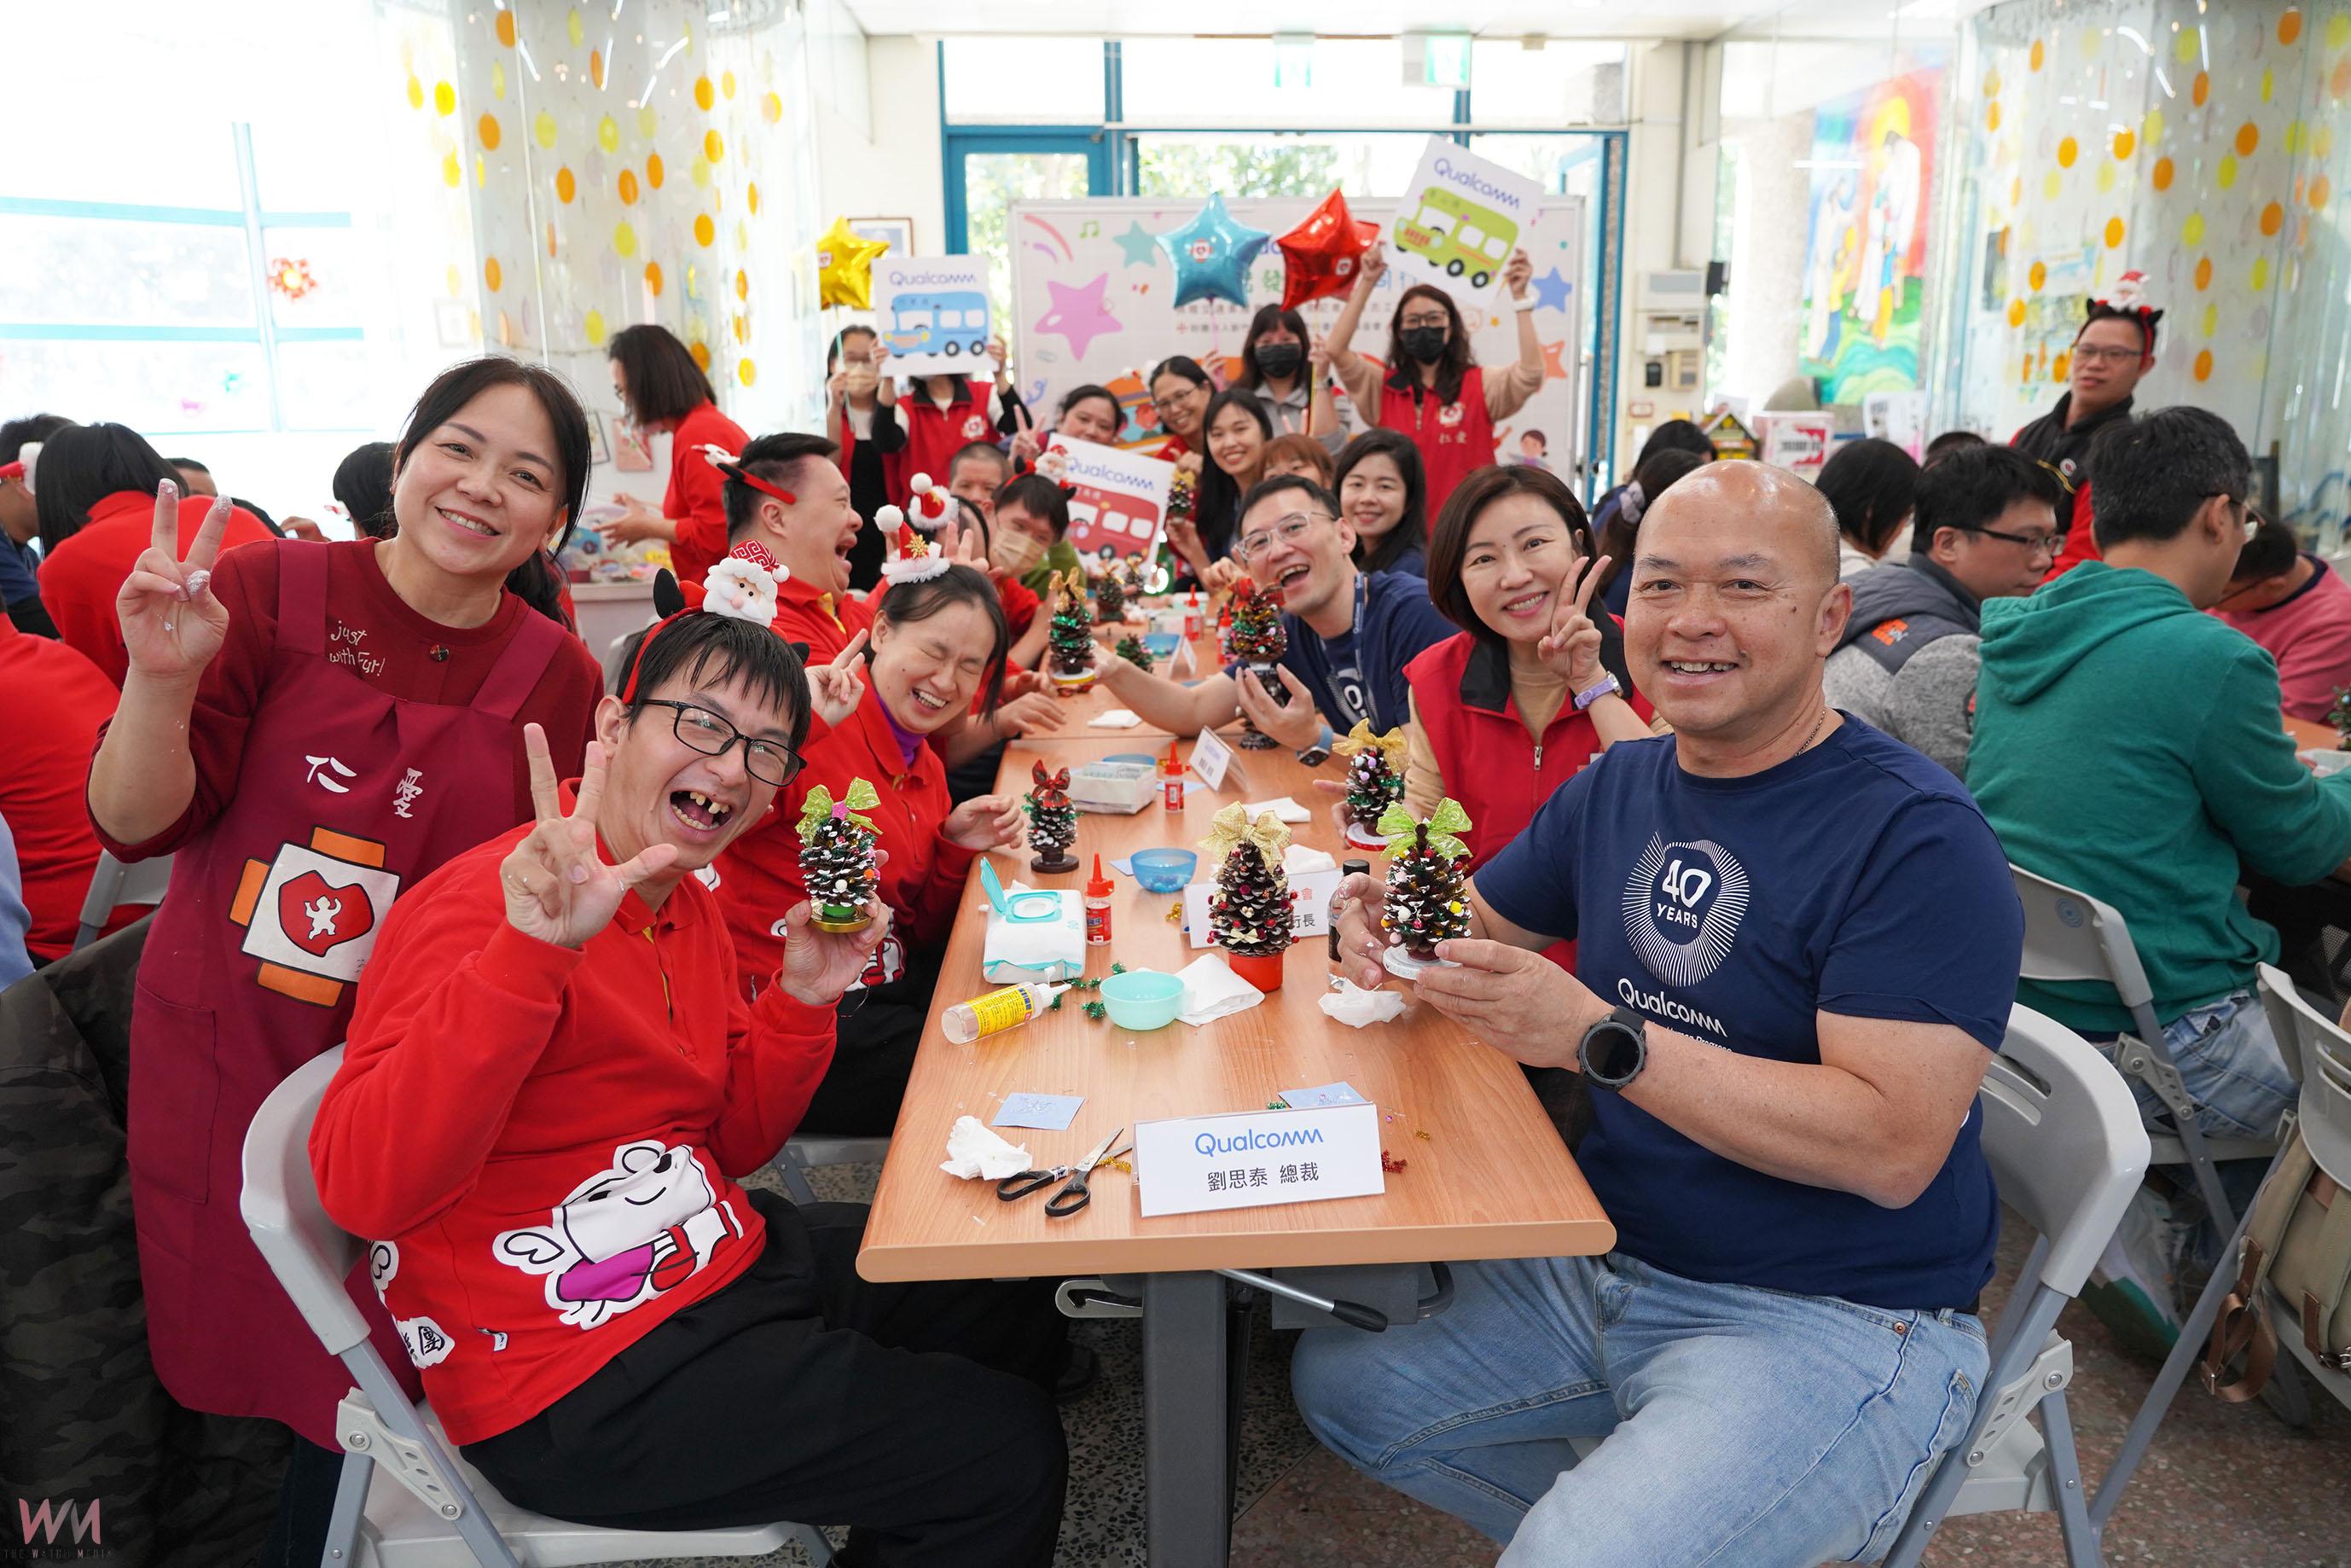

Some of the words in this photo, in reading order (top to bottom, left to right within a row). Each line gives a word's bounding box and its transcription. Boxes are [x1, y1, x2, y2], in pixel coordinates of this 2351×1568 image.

[1434, 158, 1519, 209] Qualcomm
[890, 271, 976, 286] Qualcomm
[329, 648, 356, 666] with
[1663, 859, 1712, 909] 40
[1657, 903, 1698, 929] YEARS
[1618, 978, 1727, 1037] Qualcomm
[1195, 1129, 1324, 1157] Qualcomm
[1208, 1167, 1268, 1192] 劉思泰
[1280, 1162, 1319, 1184] 總裁
